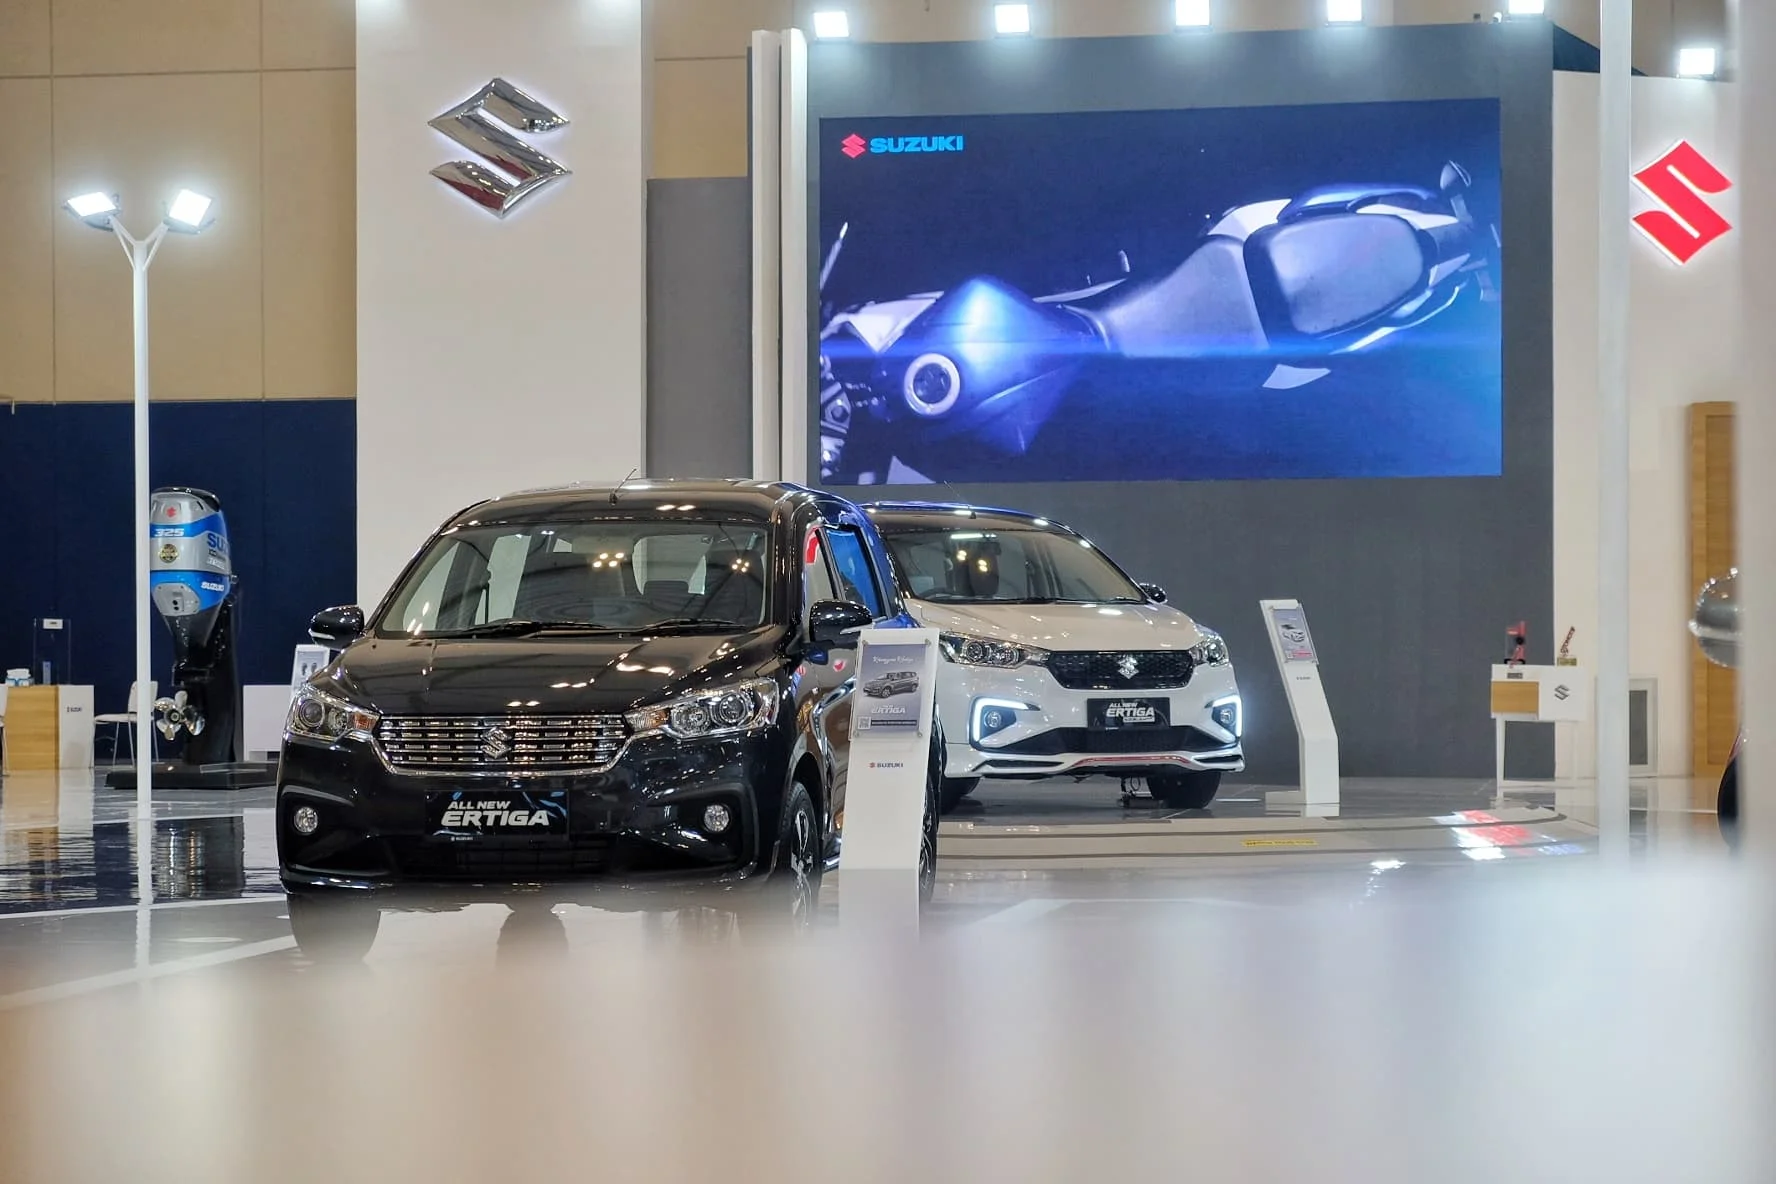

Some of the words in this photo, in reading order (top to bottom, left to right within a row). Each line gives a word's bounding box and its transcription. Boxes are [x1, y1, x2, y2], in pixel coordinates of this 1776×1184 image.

[870, 135, 963, 153] SUZUKI
[154, 527, 185, 537] 325
[1106, 707, 1155, 717] ERTIGA
[447, 800, 475, 810] ALL
[476, 800, 511, 810] NEW
[440, 809, 550, 827] ERTIGA
